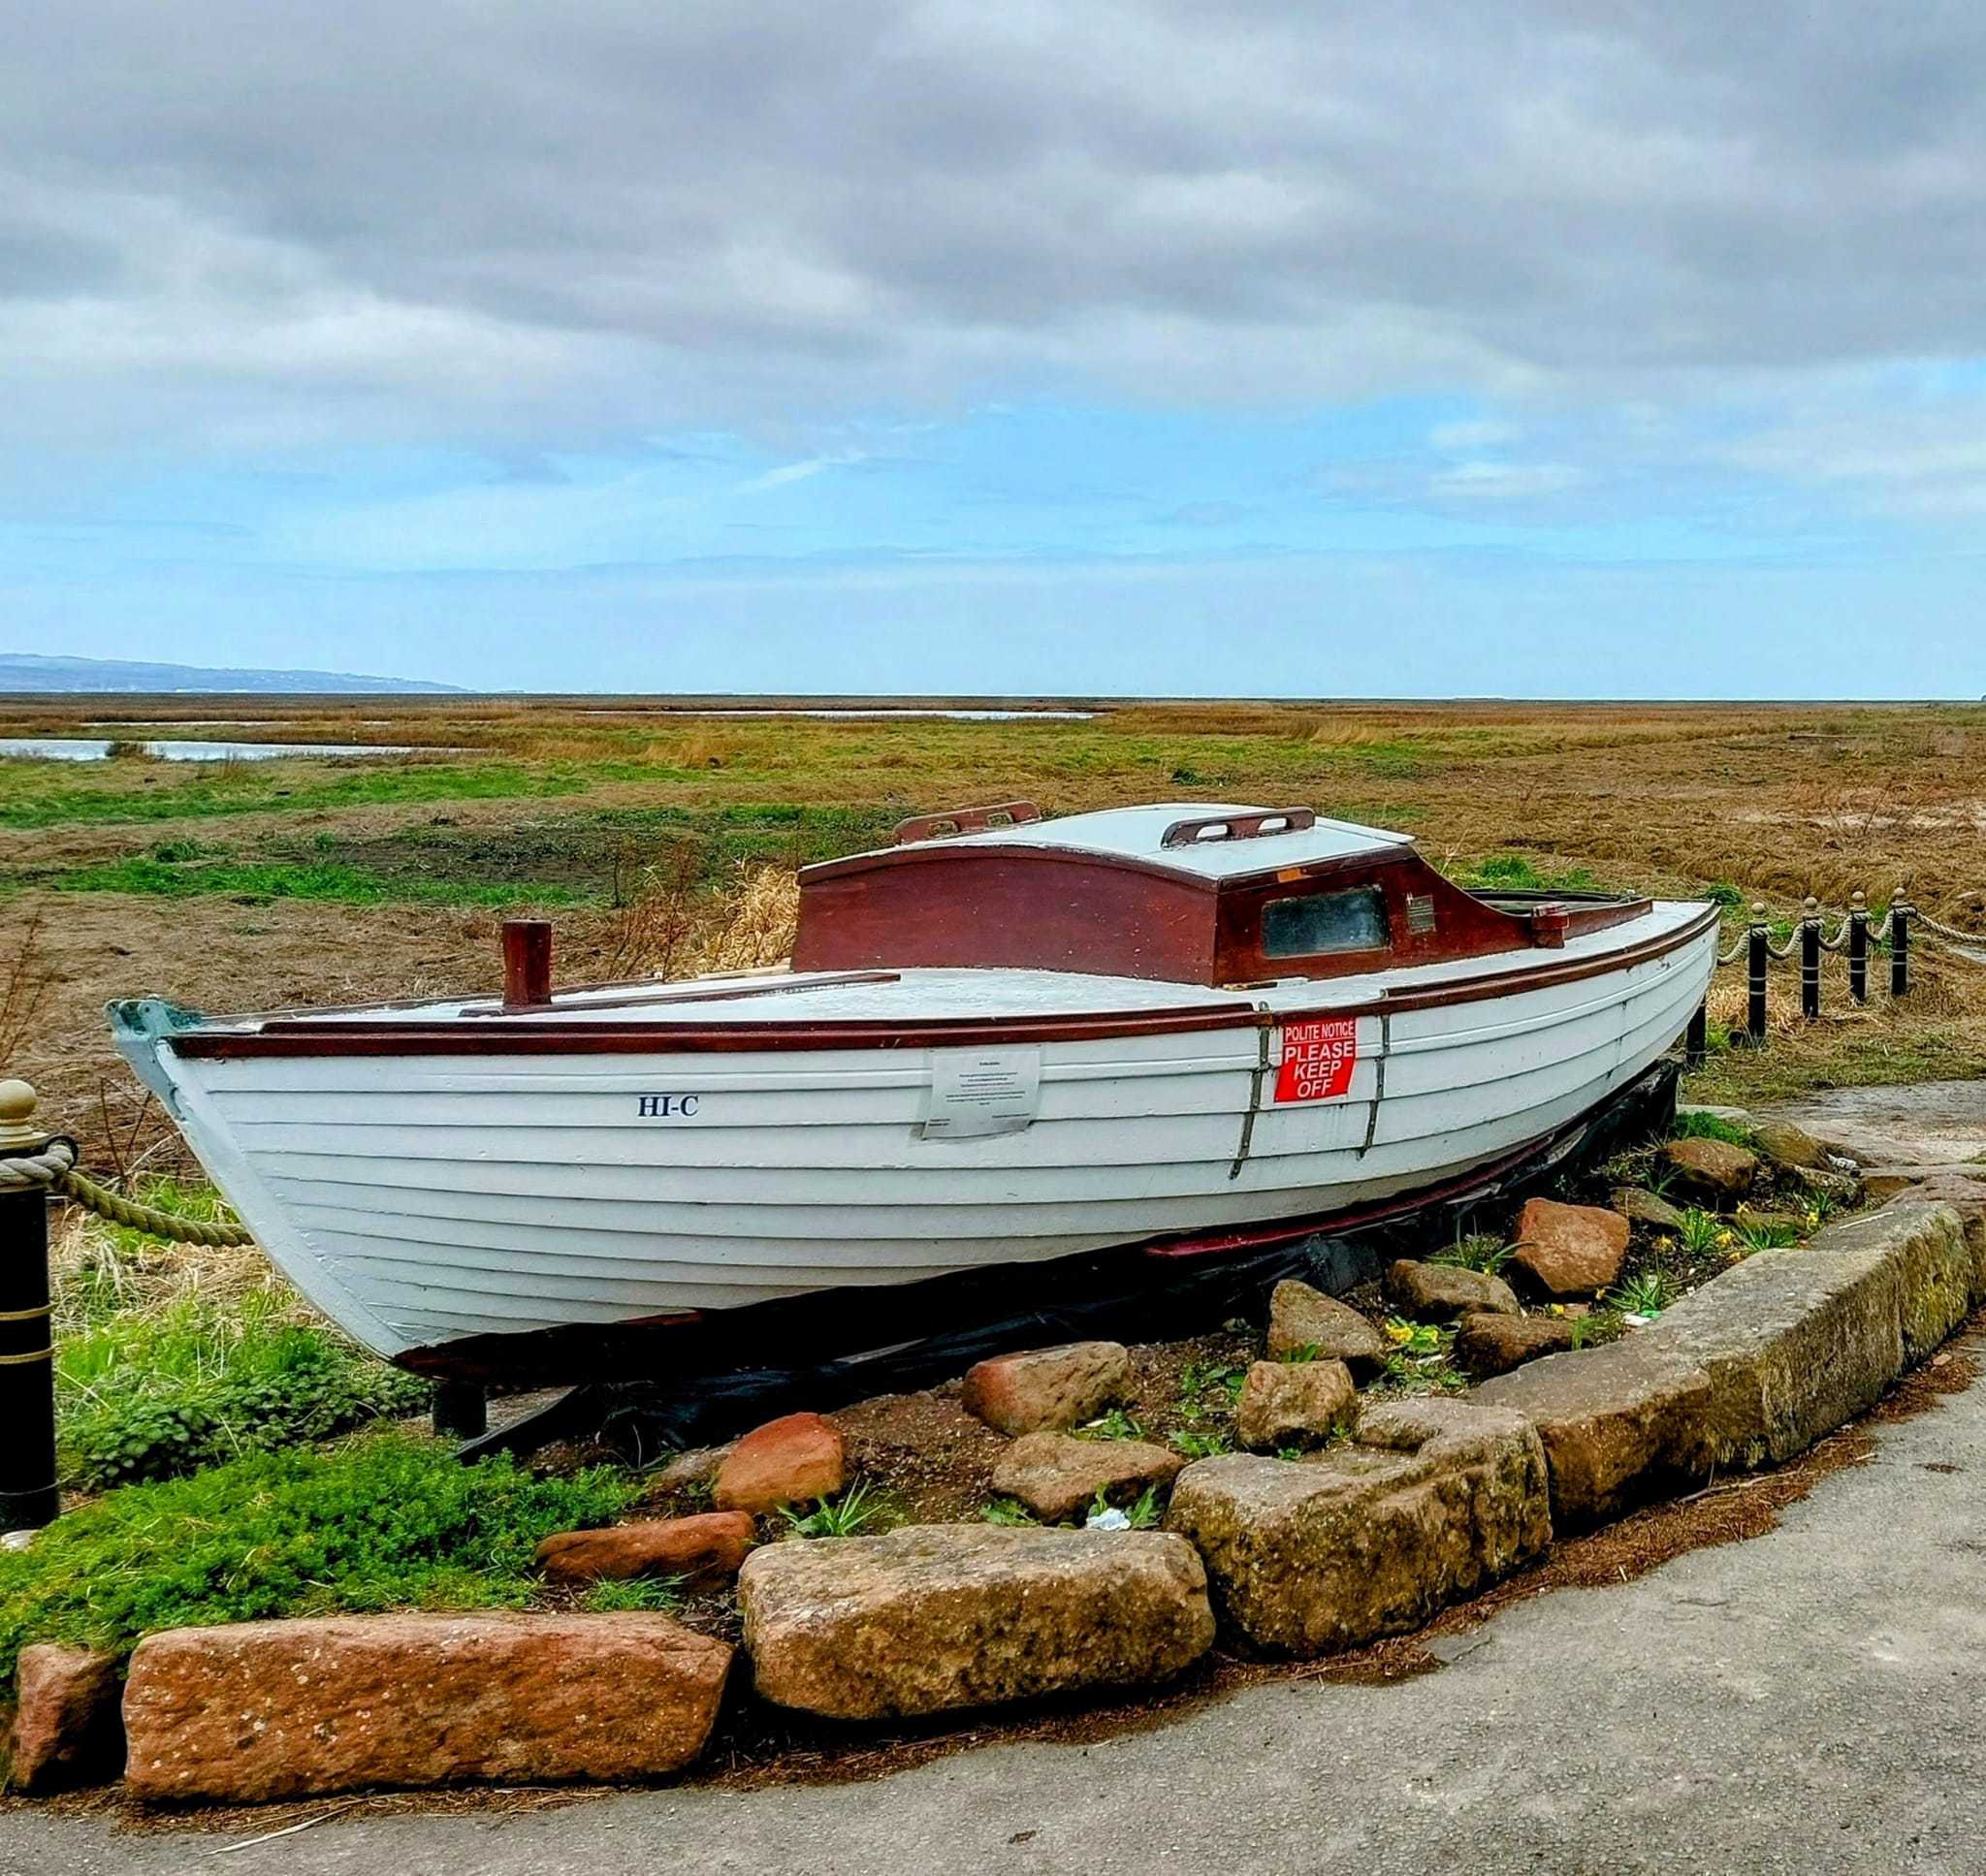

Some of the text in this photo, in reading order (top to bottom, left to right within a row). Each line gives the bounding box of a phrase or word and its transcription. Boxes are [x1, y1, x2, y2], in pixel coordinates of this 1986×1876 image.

[1285, 1021, 1355, 1042] POLITE NOTICE
[1285, 1040, 1354, 1065] PLEASE
[1294, 1060, 1342, 1081] KEEP
[1297, 1078, 1333, 1097] OFF
[638, 1096, 698, 1117] HI-C
